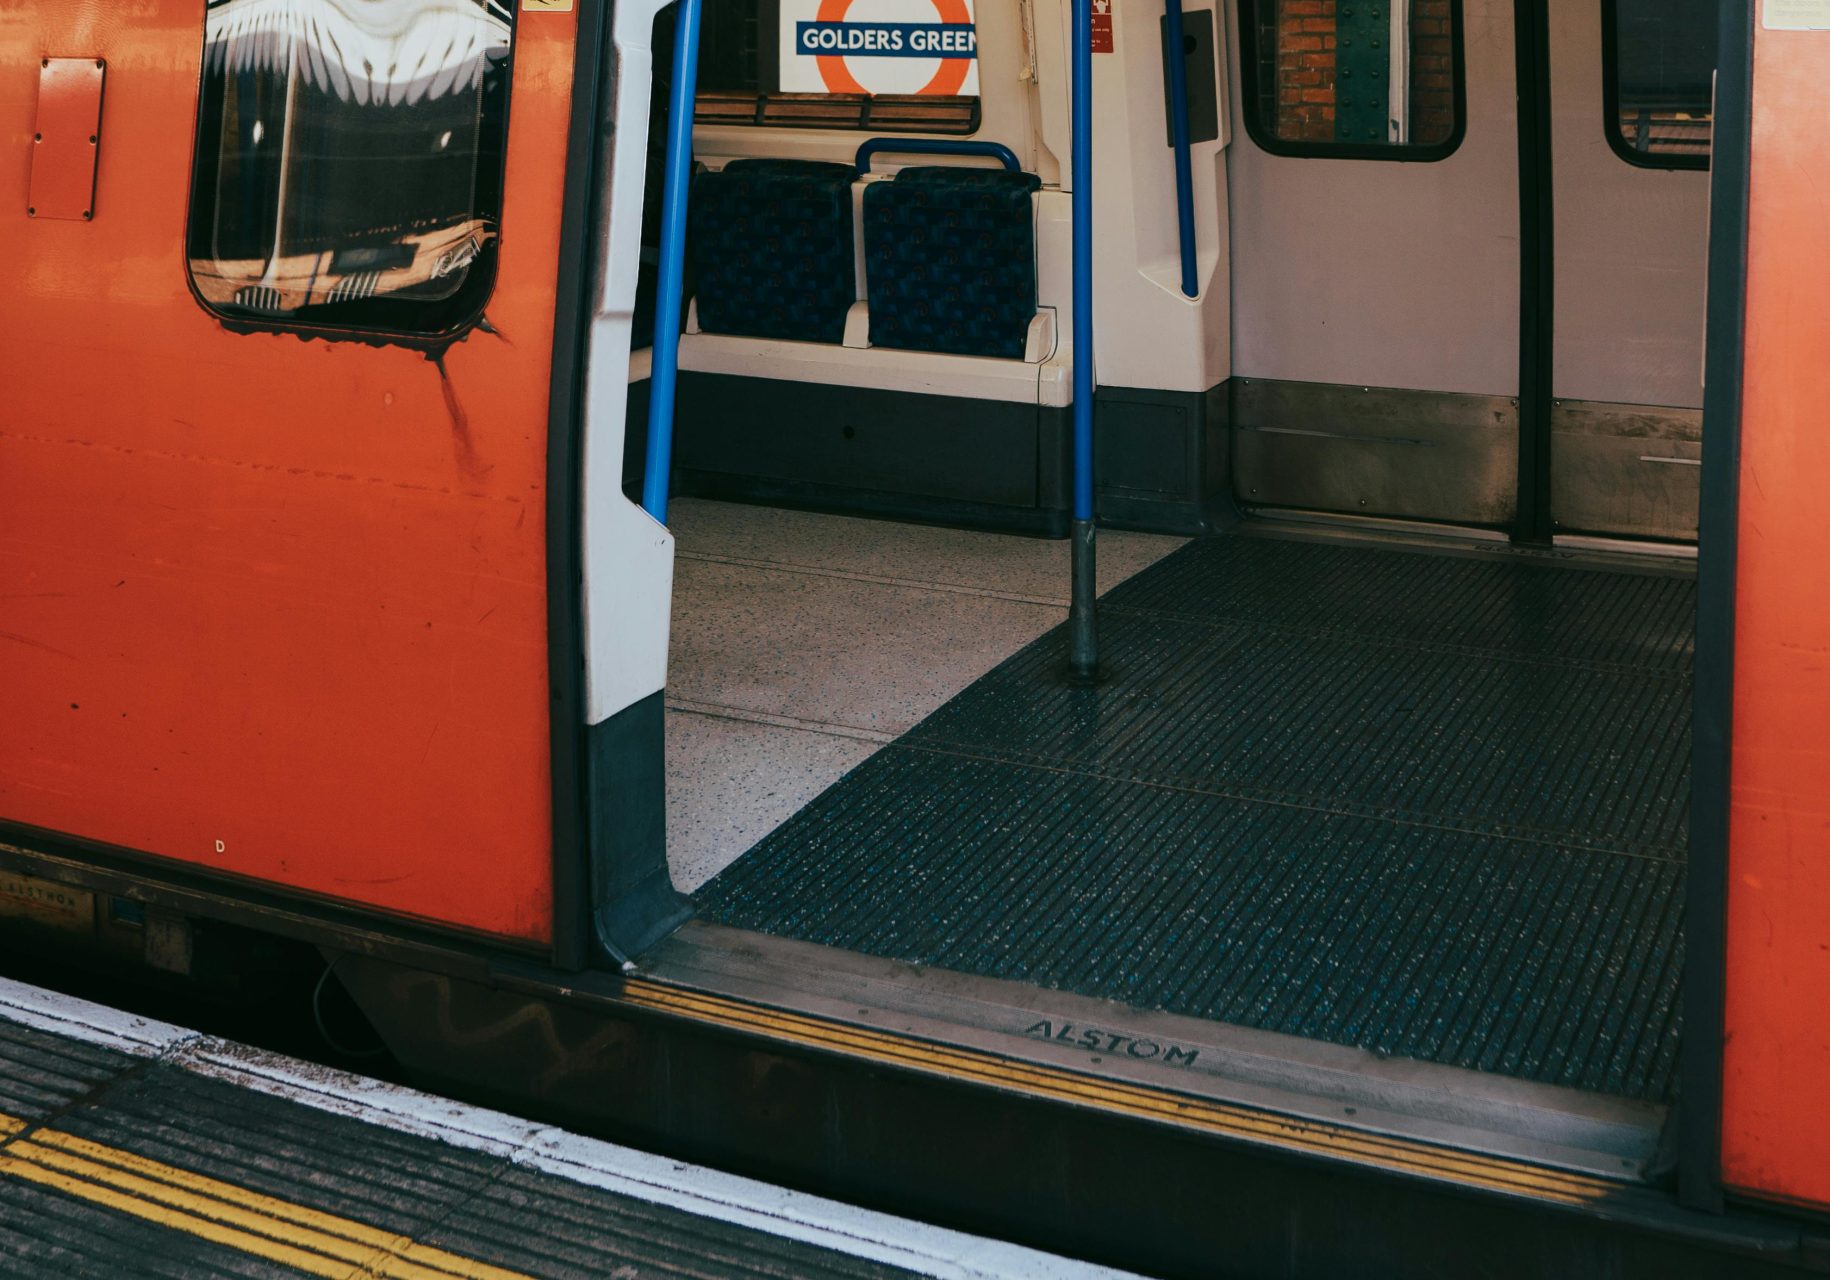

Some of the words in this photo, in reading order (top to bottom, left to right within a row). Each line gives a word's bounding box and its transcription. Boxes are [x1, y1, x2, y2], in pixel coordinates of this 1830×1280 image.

[802, 28, 903, 50] GOLDERS
[215, 839, 225, 853] D
[1025, 1019, 1200, 1066] ALSTOM
